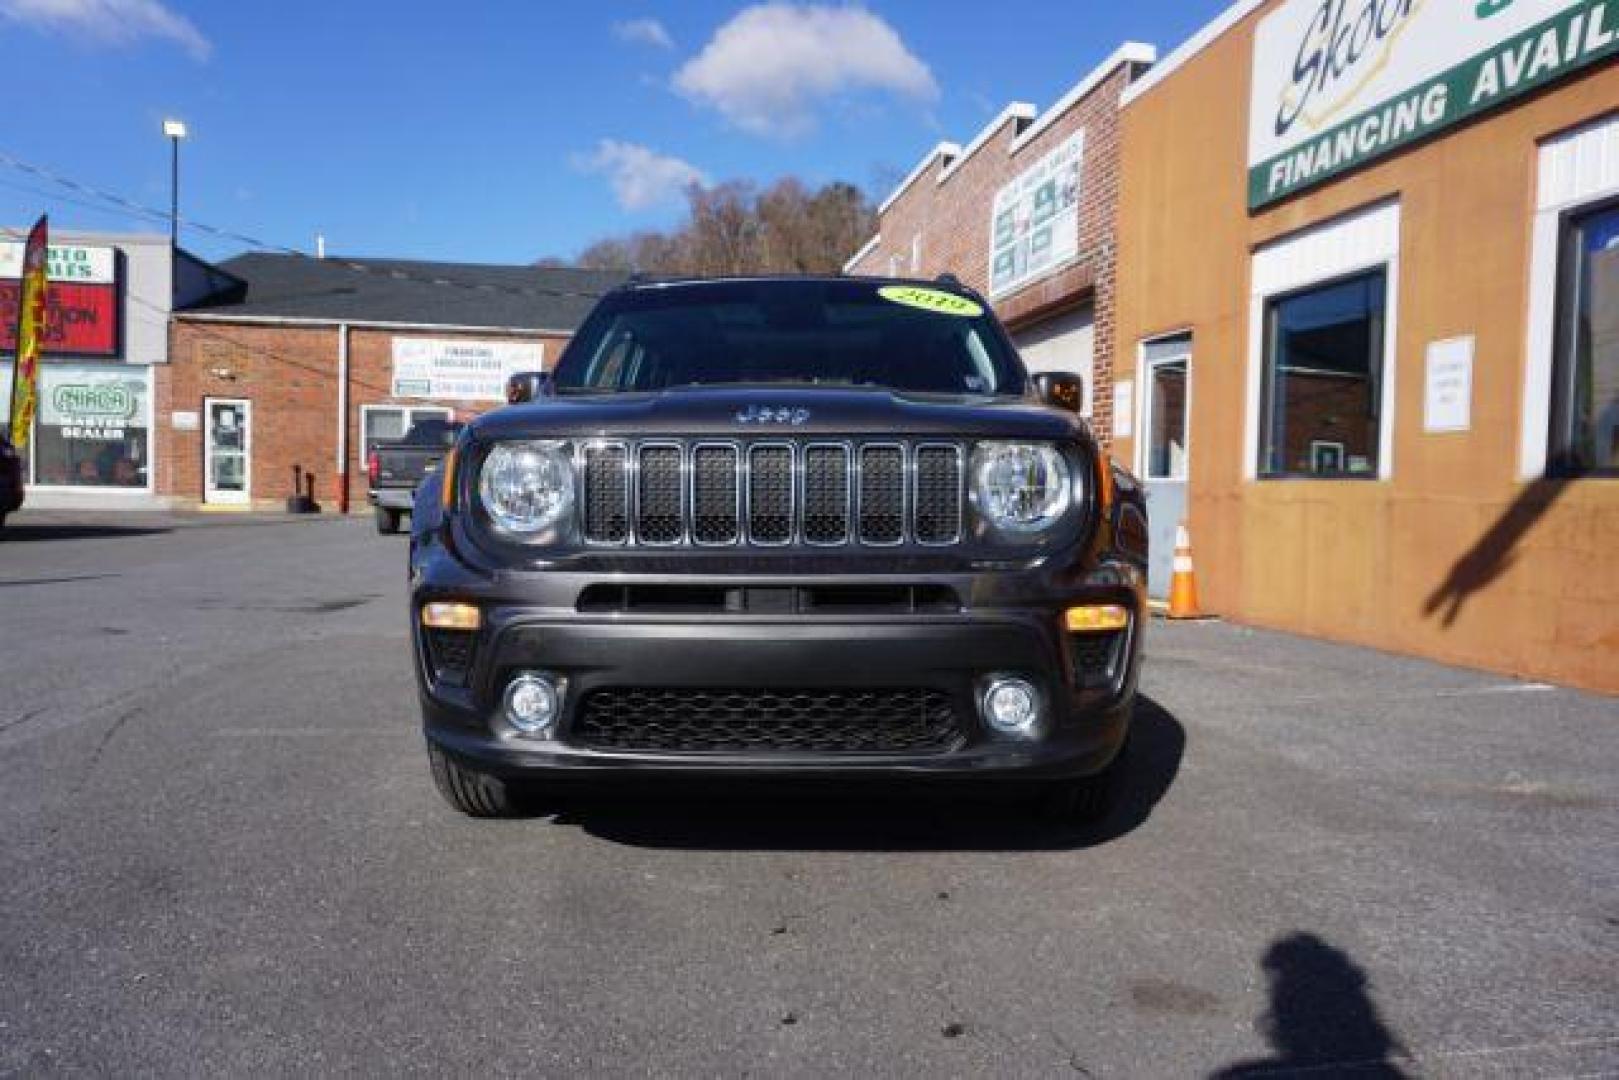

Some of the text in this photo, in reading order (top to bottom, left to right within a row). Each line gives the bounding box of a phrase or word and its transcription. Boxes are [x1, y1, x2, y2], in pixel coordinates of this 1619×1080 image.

[1268, 4, 1619, 194] FINANCING AVAIL
[736, 405, 810, 425] Jeep
